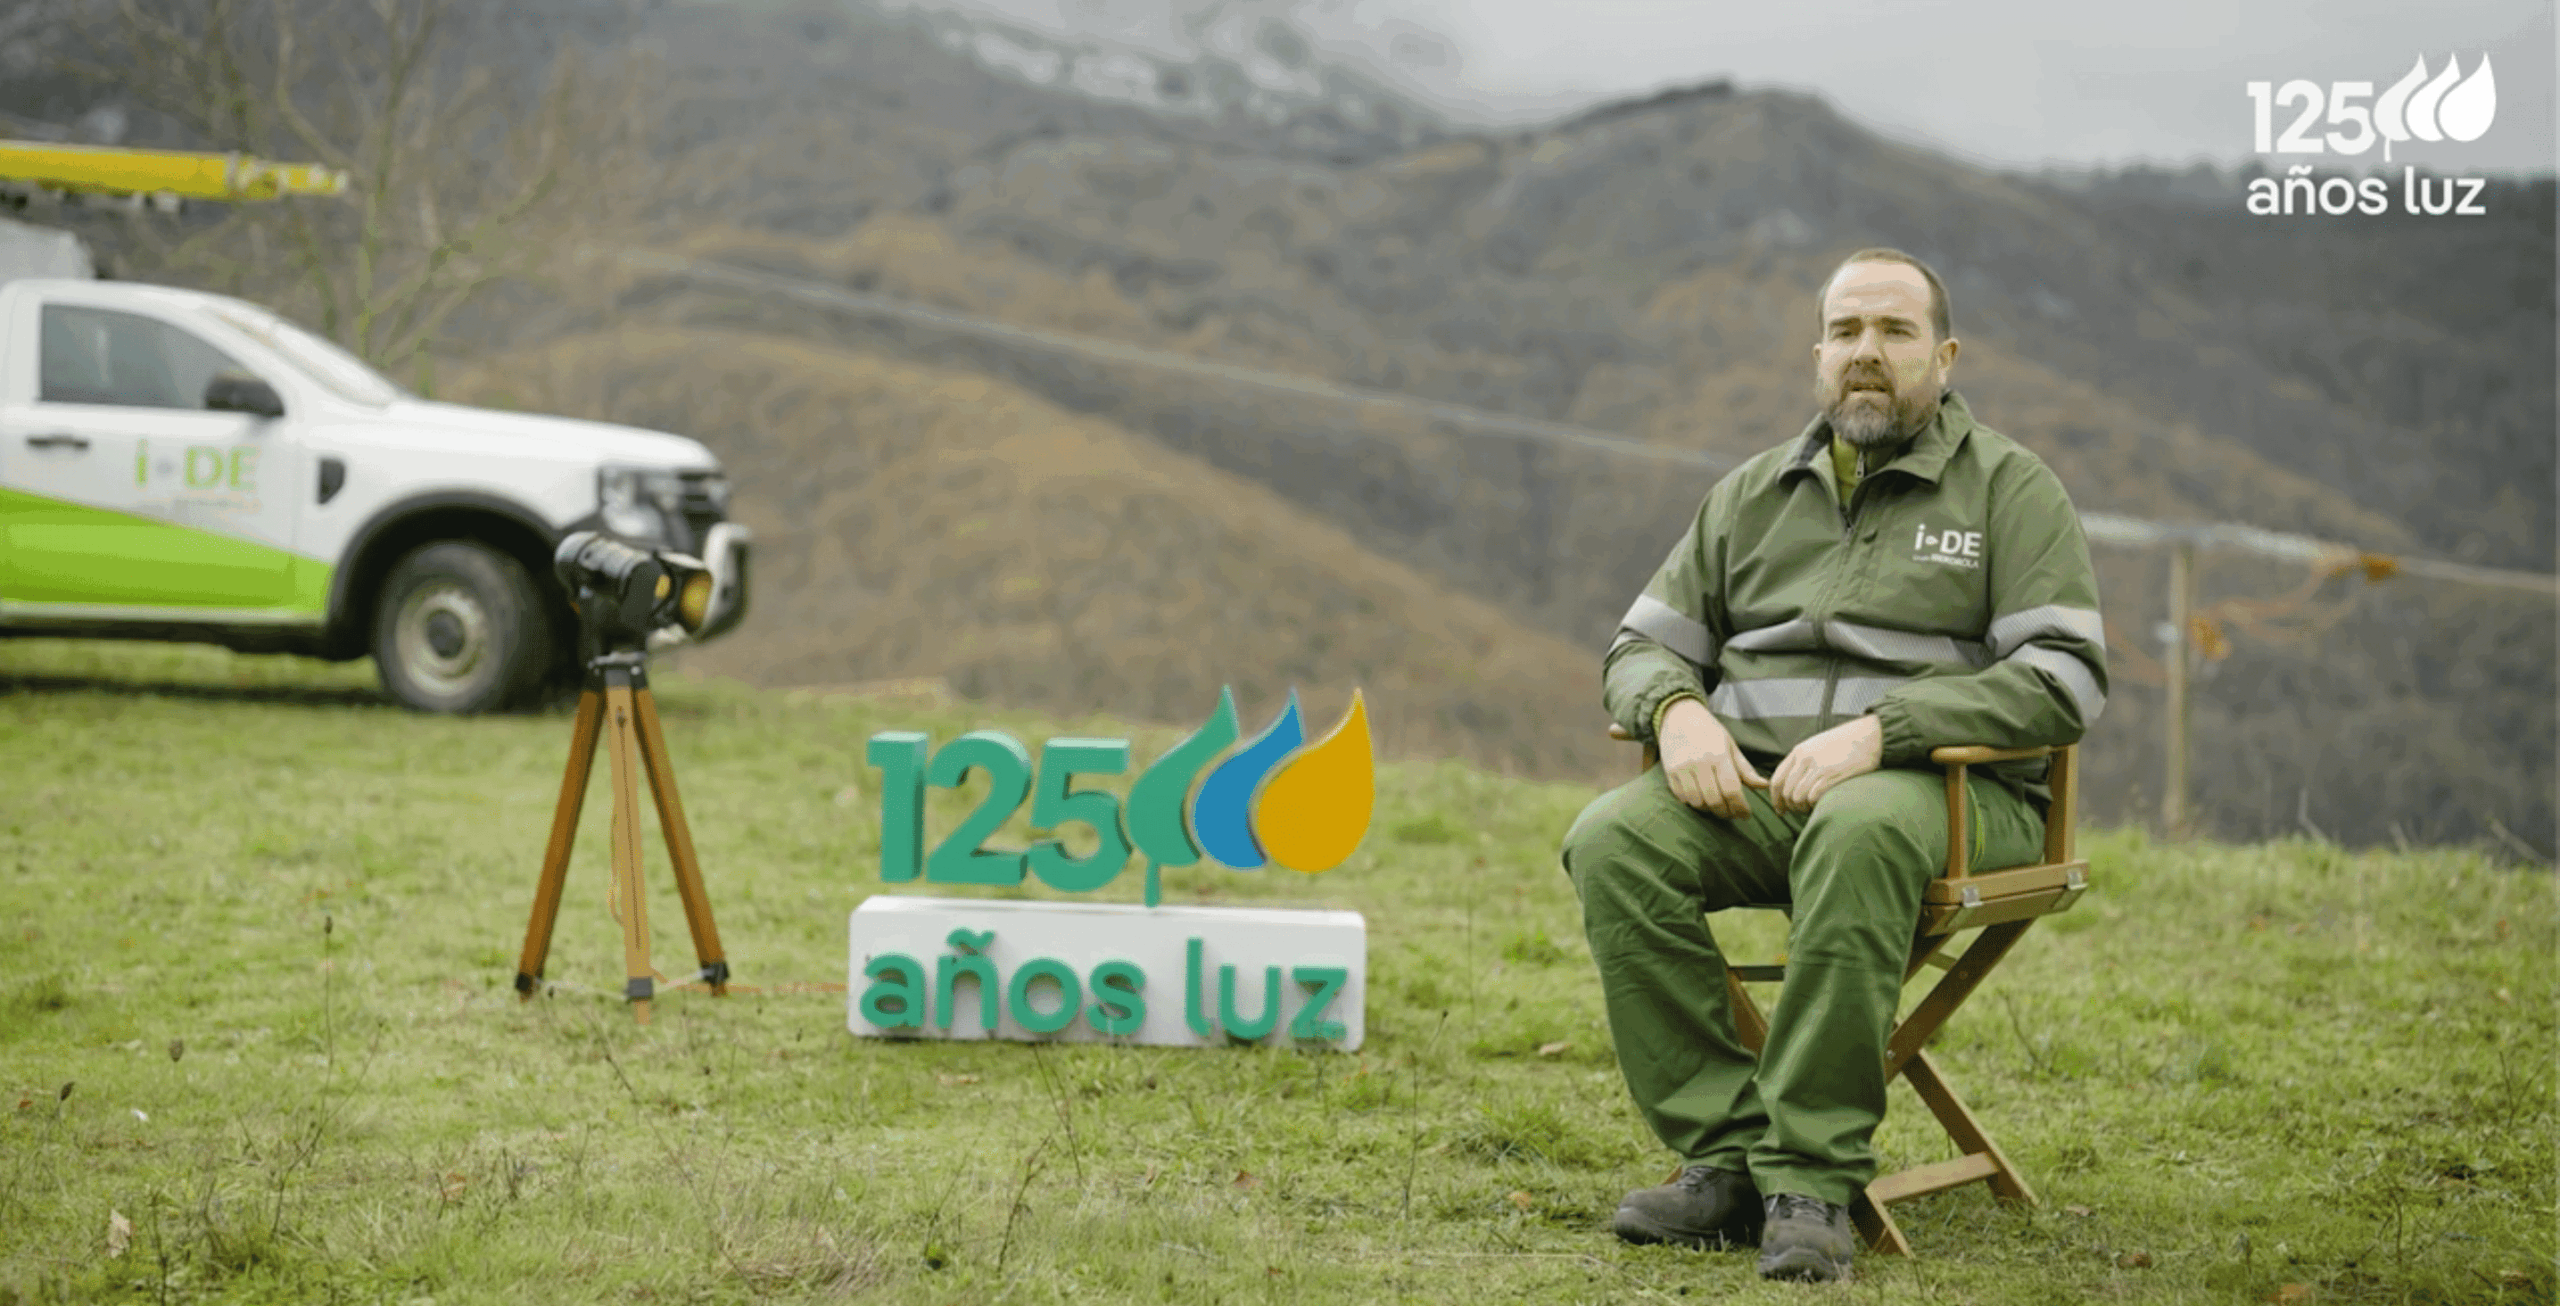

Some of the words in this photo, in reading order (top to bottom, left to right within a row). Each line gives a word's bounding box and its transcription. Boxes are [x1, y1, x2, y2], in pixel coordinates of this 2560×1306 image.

[866, 730, 1133, 893] 125
[859, 927, 1147, 1037] años
[1184, 937, 1349, 1041] luz
